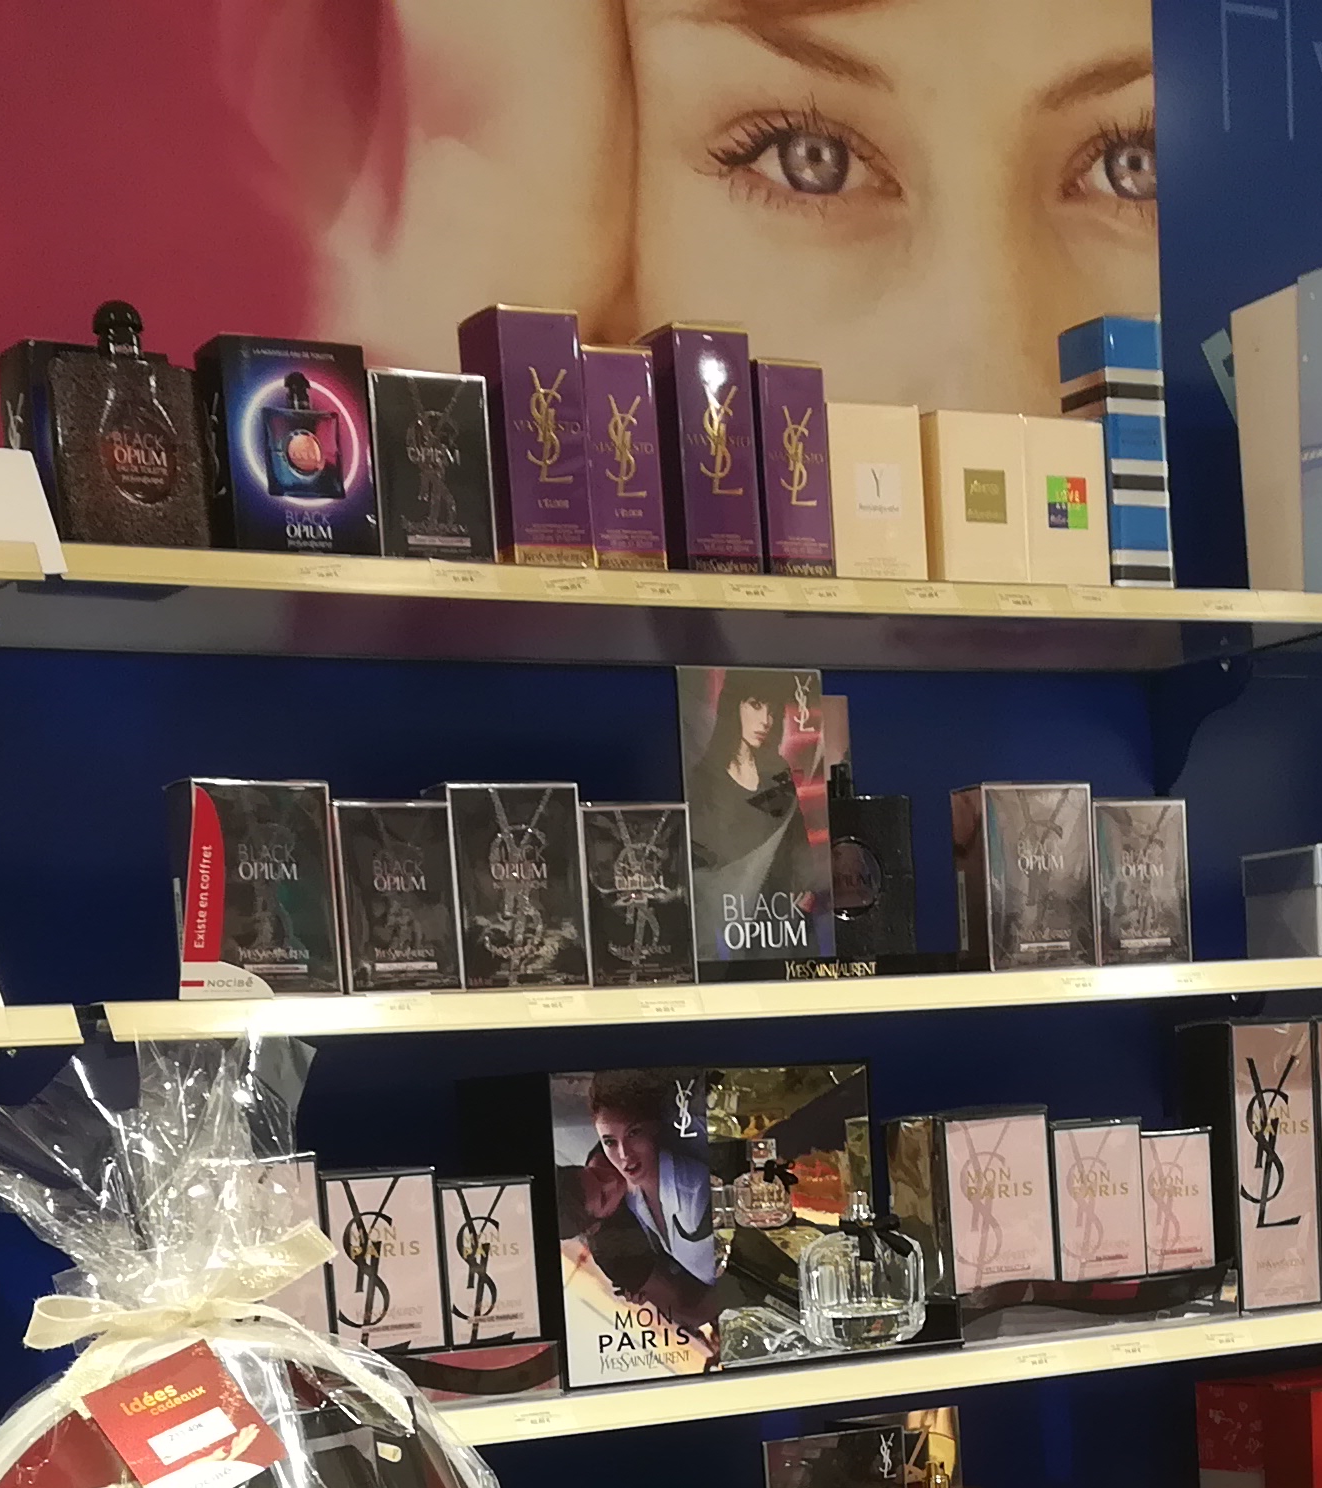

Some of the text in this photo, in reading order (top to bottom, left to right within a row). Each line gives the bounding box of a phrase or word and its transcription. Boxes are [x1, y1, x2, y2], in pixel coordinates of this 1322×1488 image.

[113, 446, 167, 467] OPIUM
[285, 510, 331, 526] BLACK
[286, 523, 333, 541] OPIUM
[199, 845, 212, 886] coffret
[238, 861, 299, 881] OPIUM
[1018, 853, 1065, 873] OPIUM
[1122, 862, 1165, 879] OPIUM
[374, 874, 427, 892] OPIUM
[723, 892, 807, 922] BLACK
[193, 908, 206, 949] Existe
[725, 920, 808, 951] OPIUM
[967, 1167, 1012, 1185] MON
[967, 1181, 1034, 1200] PARIS
[1072, 1182, 1129, 1199] PARIS
[615, 1308, 674, 1330] MON
[598, 1327, 691, 1353] PARIS
[120, 1384, 178, 1416] idées
